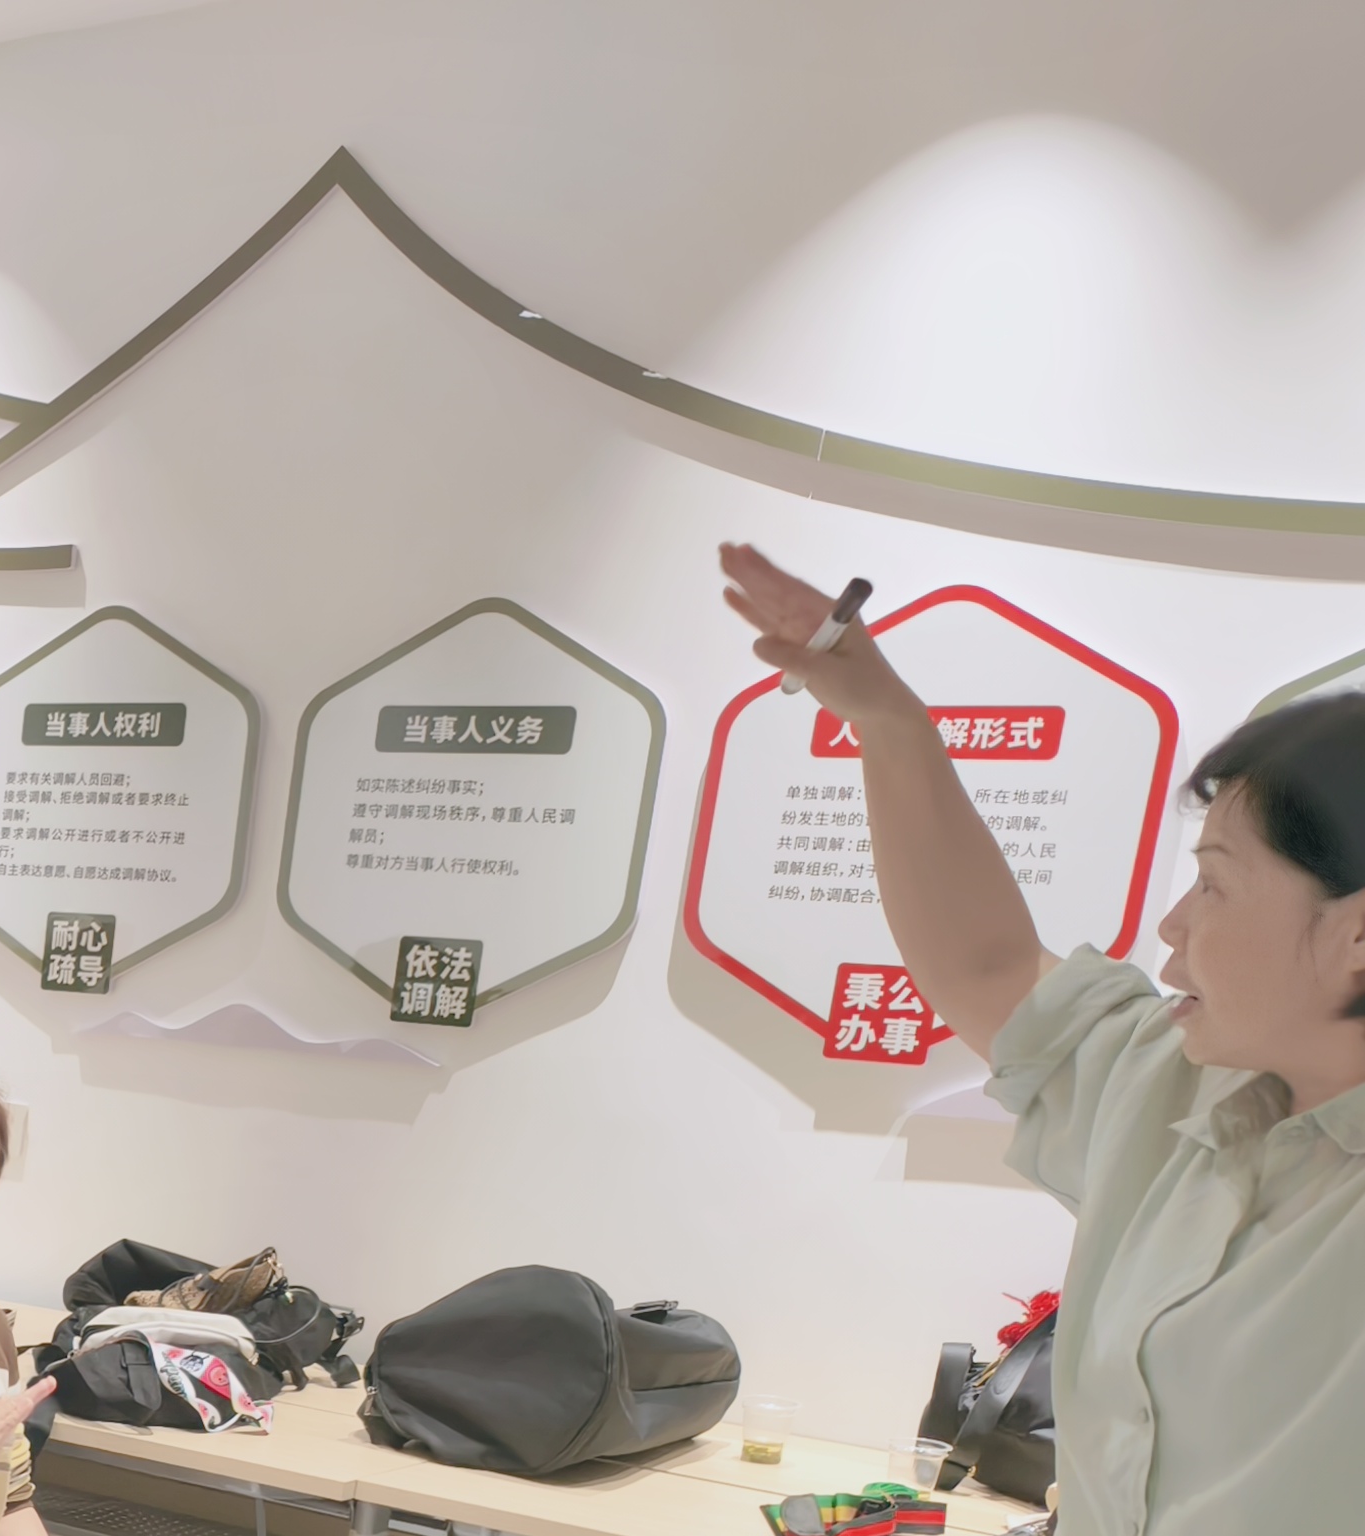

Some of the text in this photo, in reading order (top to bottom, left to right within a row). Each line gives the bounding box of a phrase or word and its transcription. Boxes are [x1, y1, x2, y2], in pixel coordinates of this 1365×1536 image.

[44, 711, 162, 740] 当事人权利
[403, 714, 544, 746] 当事人义务
[51, 920, 108, 952] 耐心
[47, 953, 104, 987] 疏导
[405, 944, 473, 982] 依法
[400, 981, 469, 1020] 调解
[835, 1014, 922, 1056] 办事
